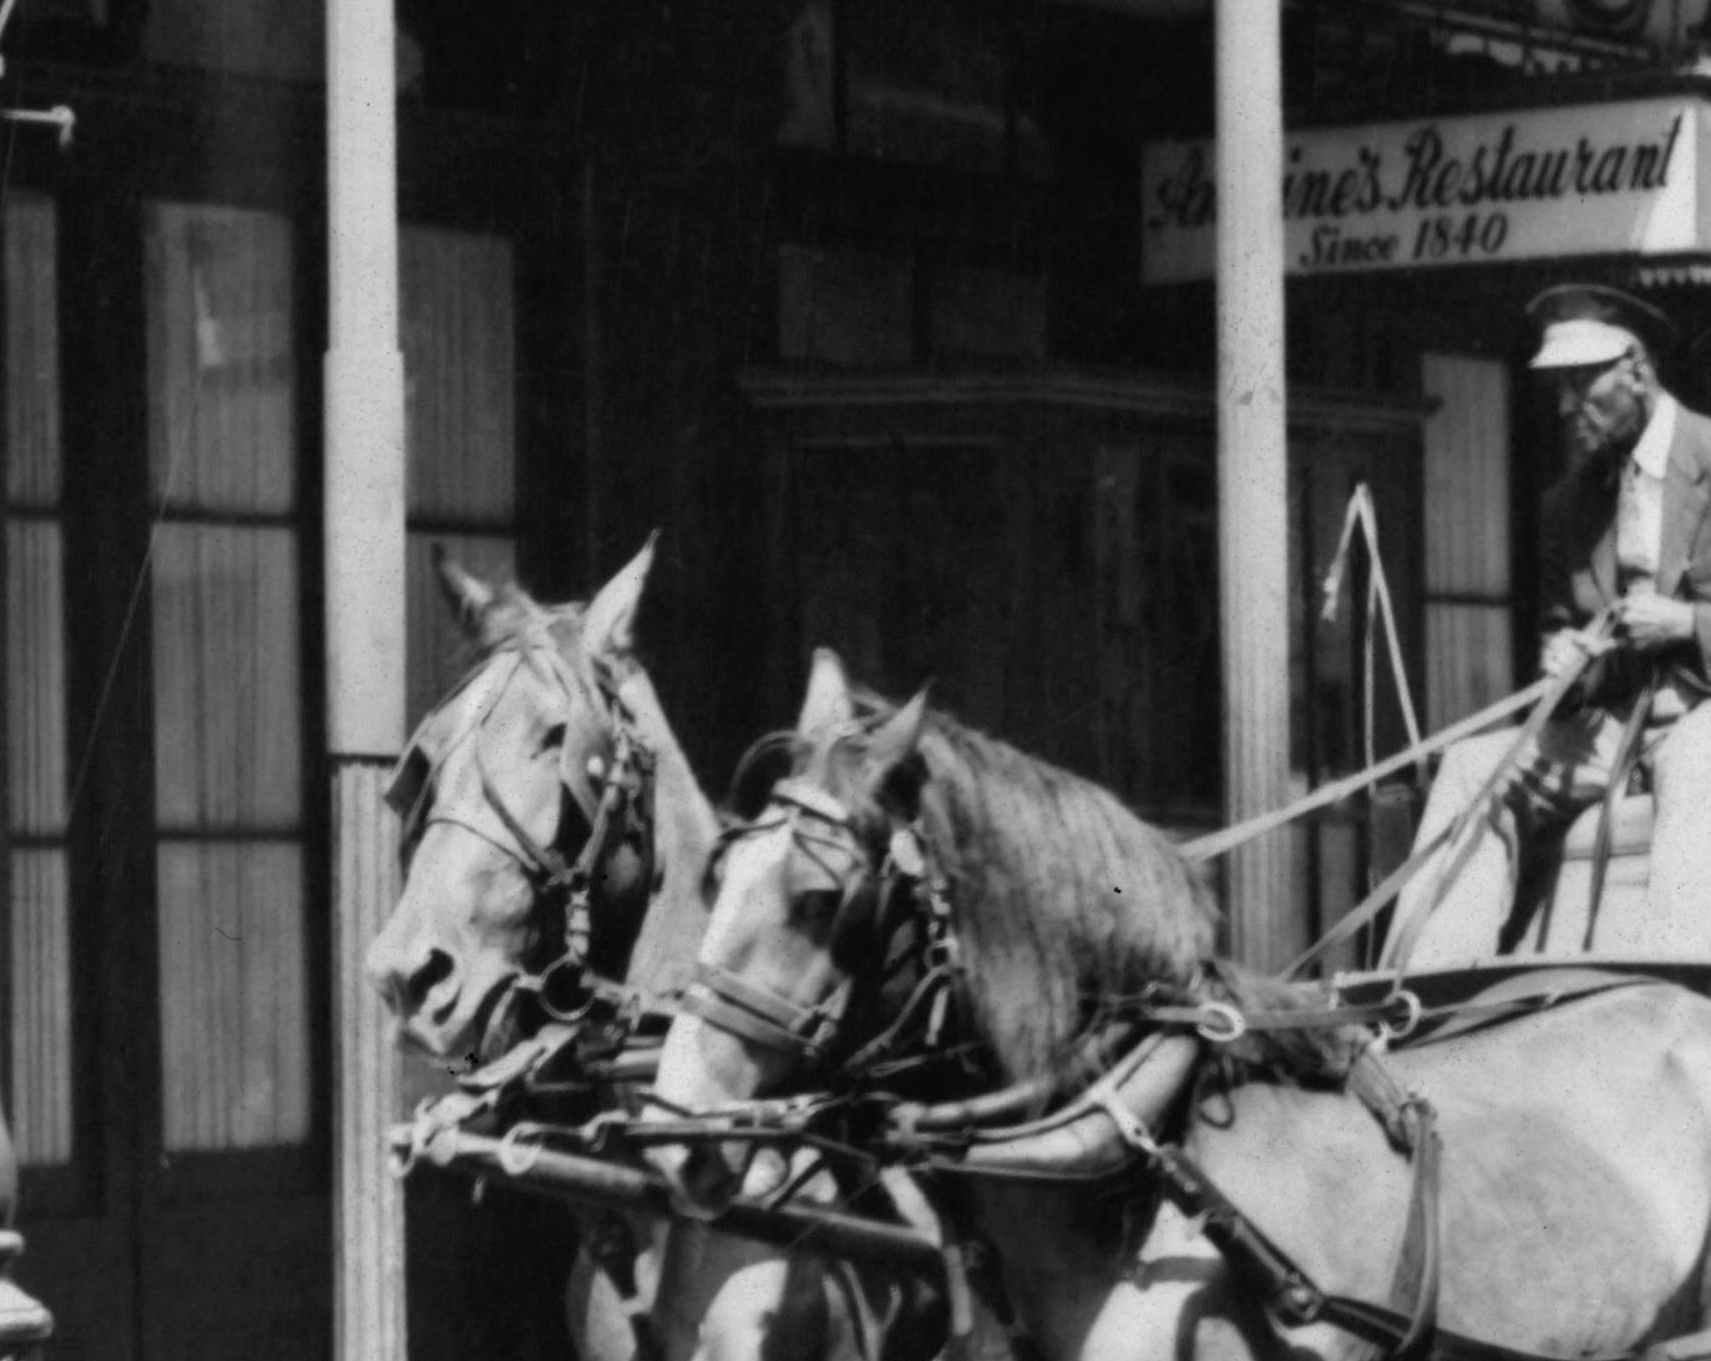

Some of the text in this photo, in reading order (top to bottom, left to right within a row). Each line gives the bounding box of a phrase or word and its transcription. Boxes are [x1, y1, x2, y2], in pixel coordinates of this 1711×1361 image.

[1387, 113, 1684, 210] Restaurant
[1297, 211, 1509, 266] Since 1840
